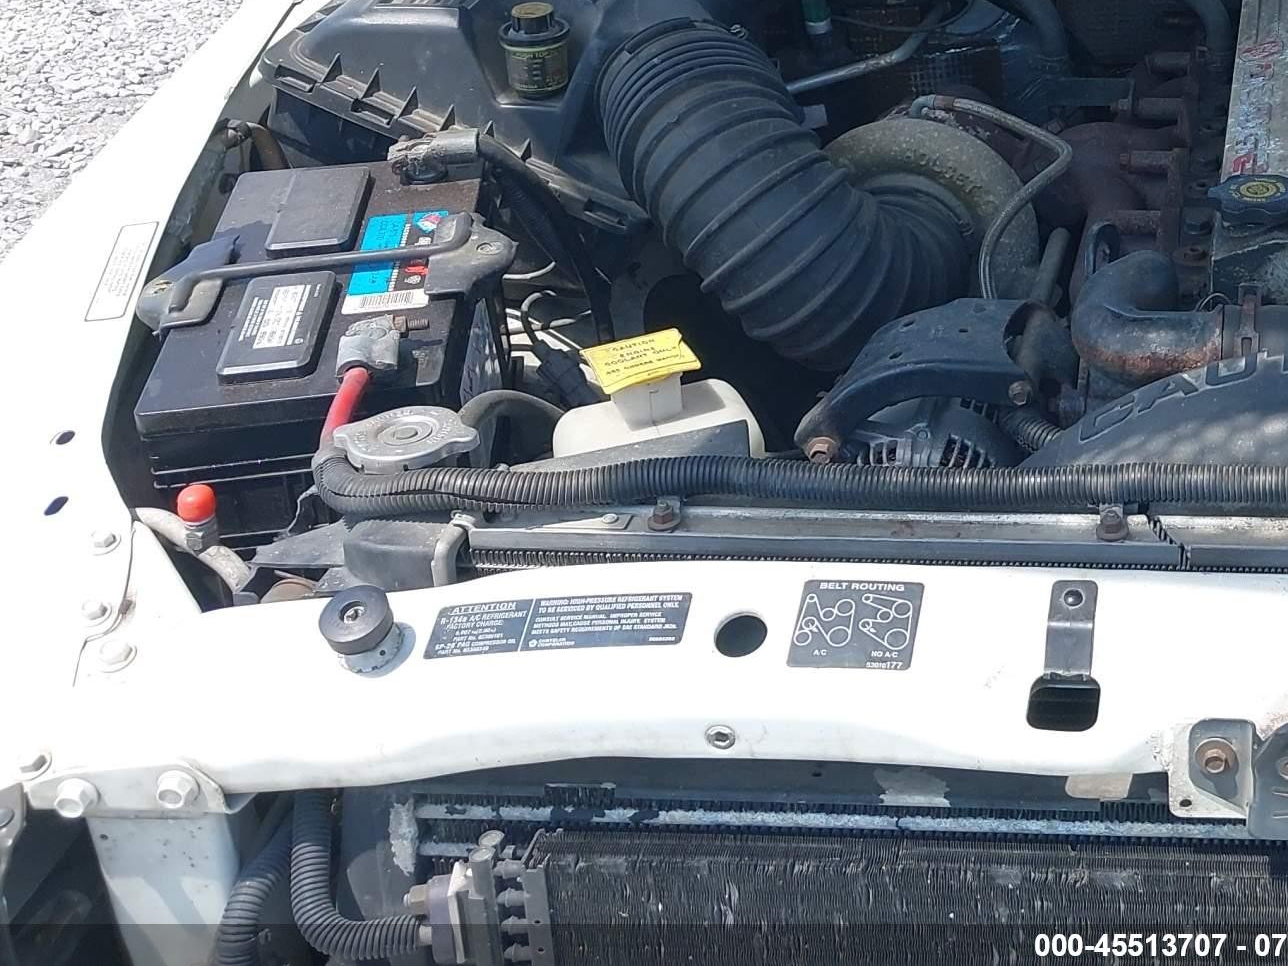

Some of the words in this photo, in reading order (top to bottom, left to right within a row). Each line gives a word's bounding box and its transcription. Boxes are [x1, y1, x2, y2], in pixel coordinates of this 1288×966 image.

[612, 338, 655, 351] CAUTION
[851, 583, 905, 591] ROUTING
[452, 602, 517, 614] ATTENTION
[481, 610, 528, 620] REFRIGERANT
[445, 621, 475, 630] FACTORY
